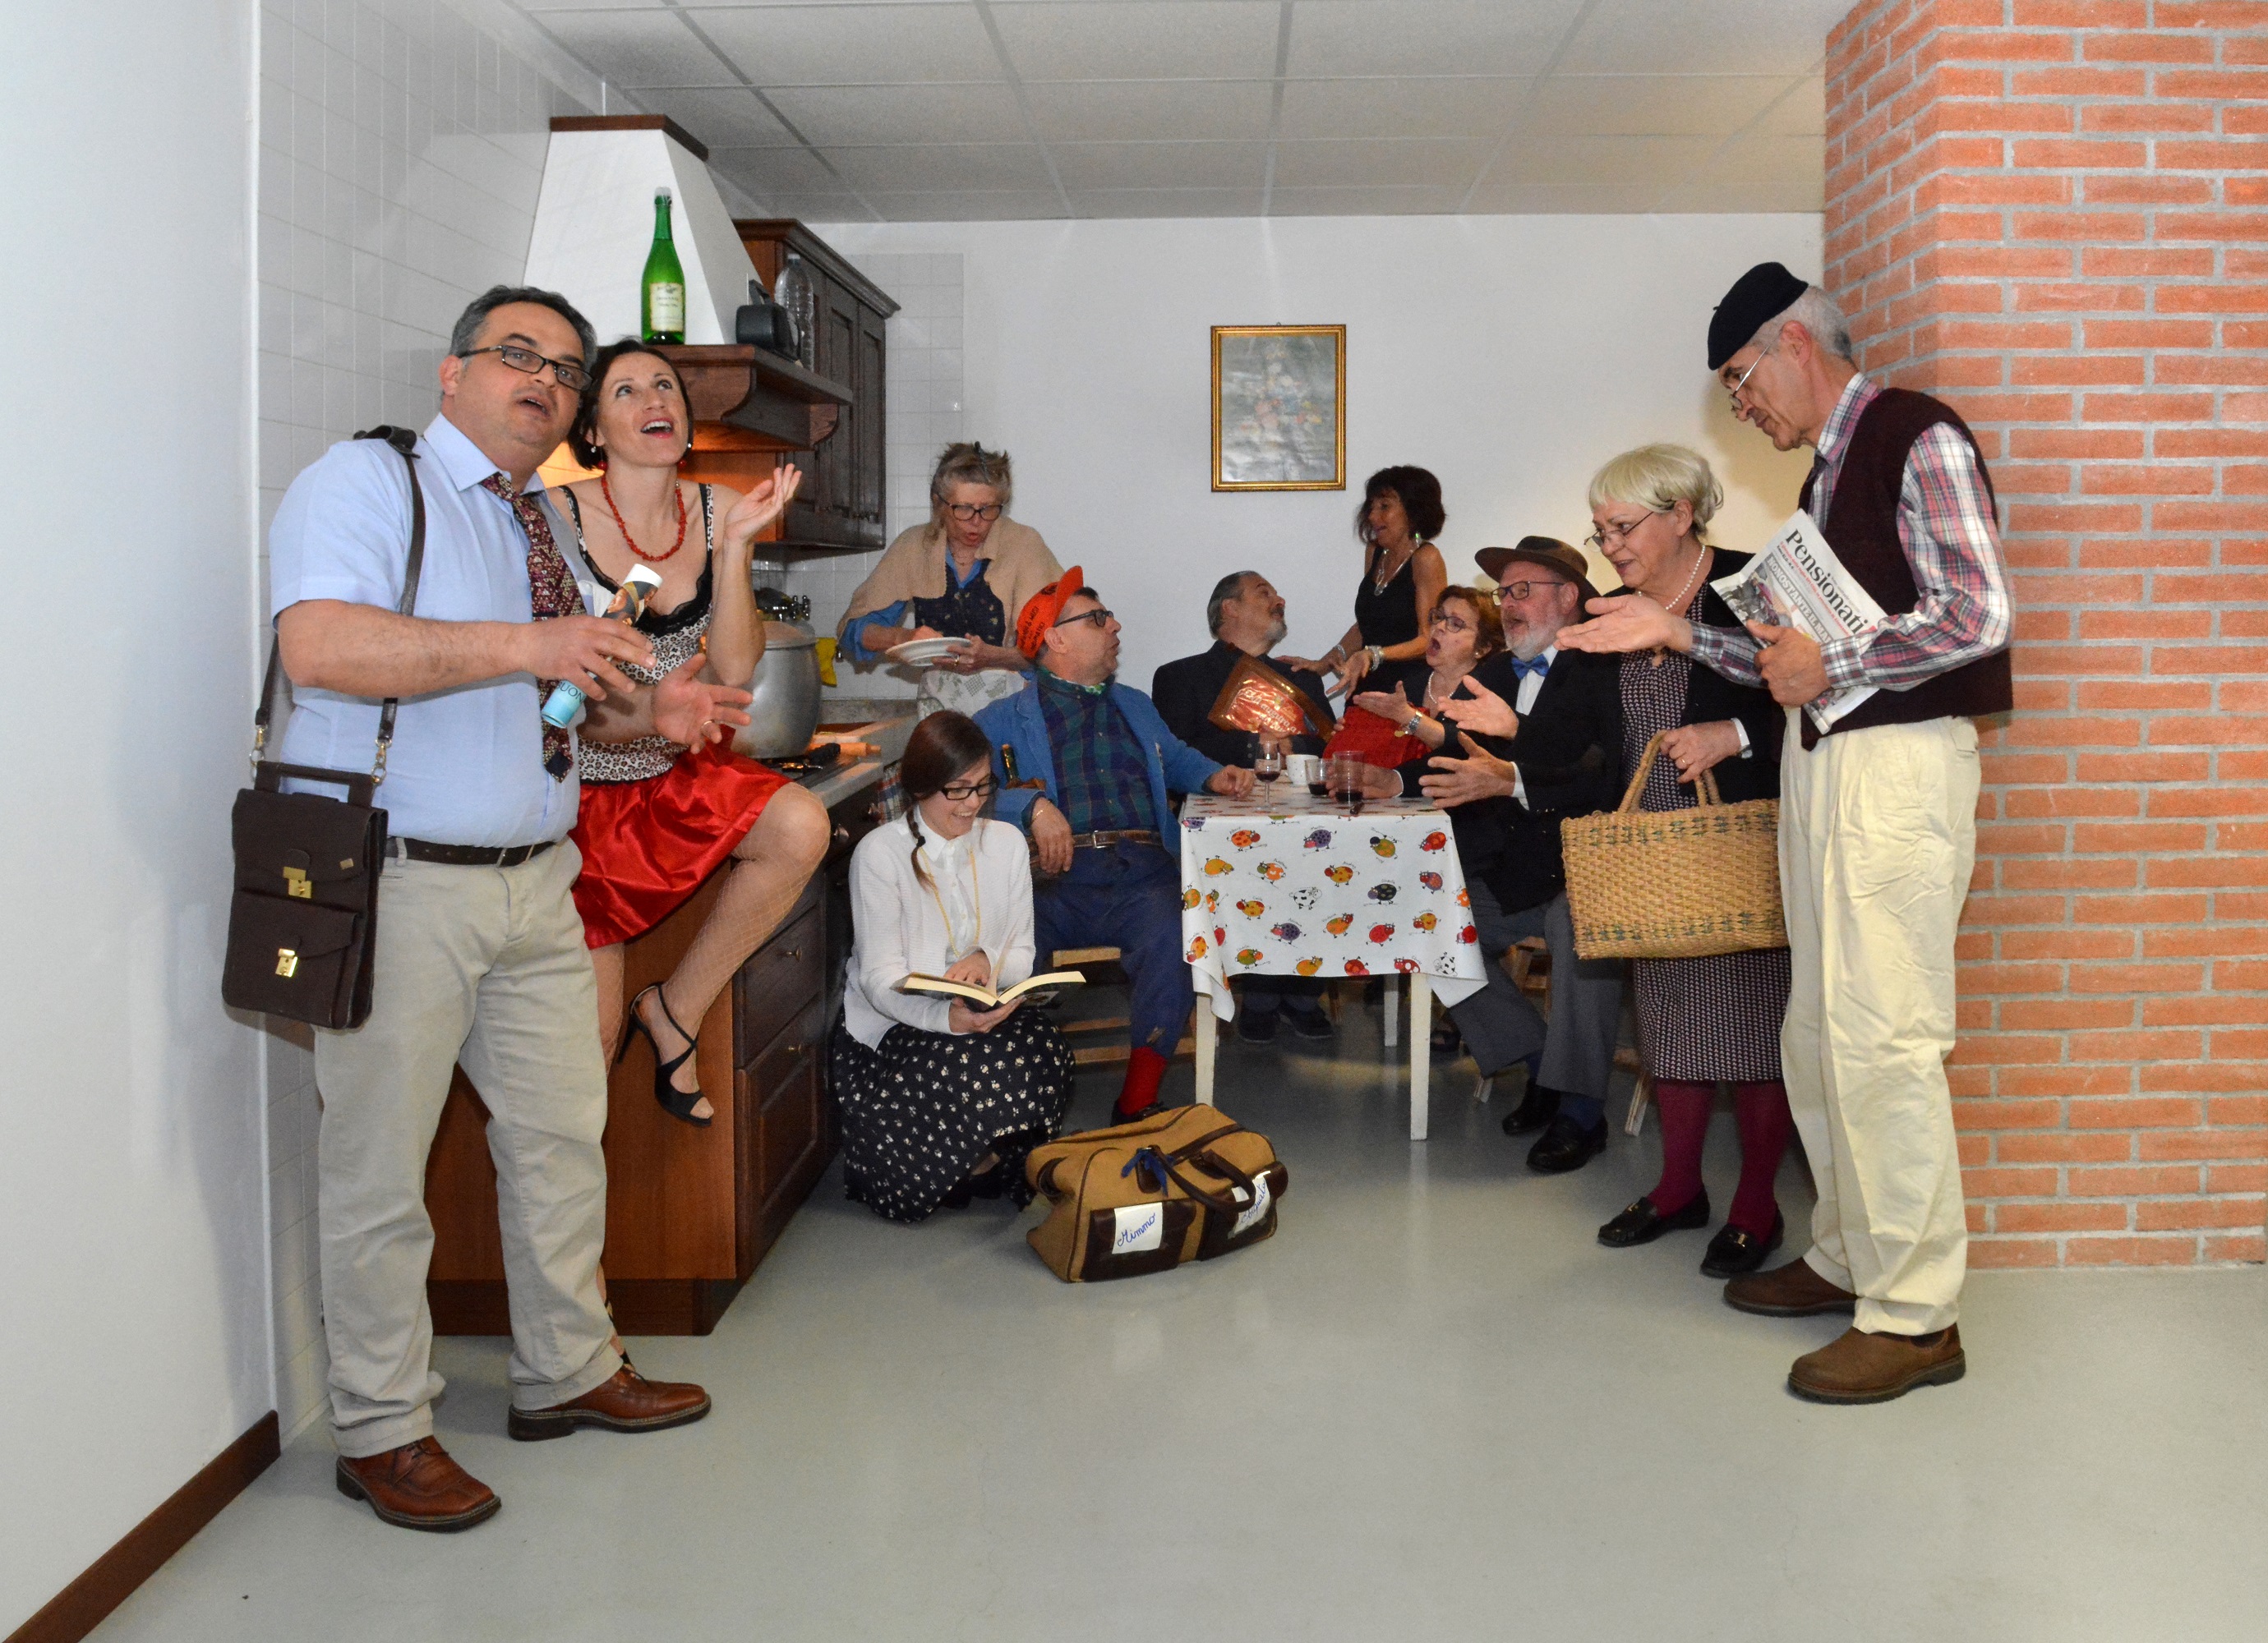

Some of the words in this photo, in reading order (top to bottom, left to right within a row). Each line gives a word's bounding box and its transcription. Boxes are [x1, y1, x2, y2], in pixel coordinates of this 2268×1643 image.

[1765, 556, 1811, 617] NONOSTANTE
[1807, 614, 1819, 626] IL
[1786, 529, 1868, 633] Pensionati
[1117, 1212, 1157, 1247] Mimmo
